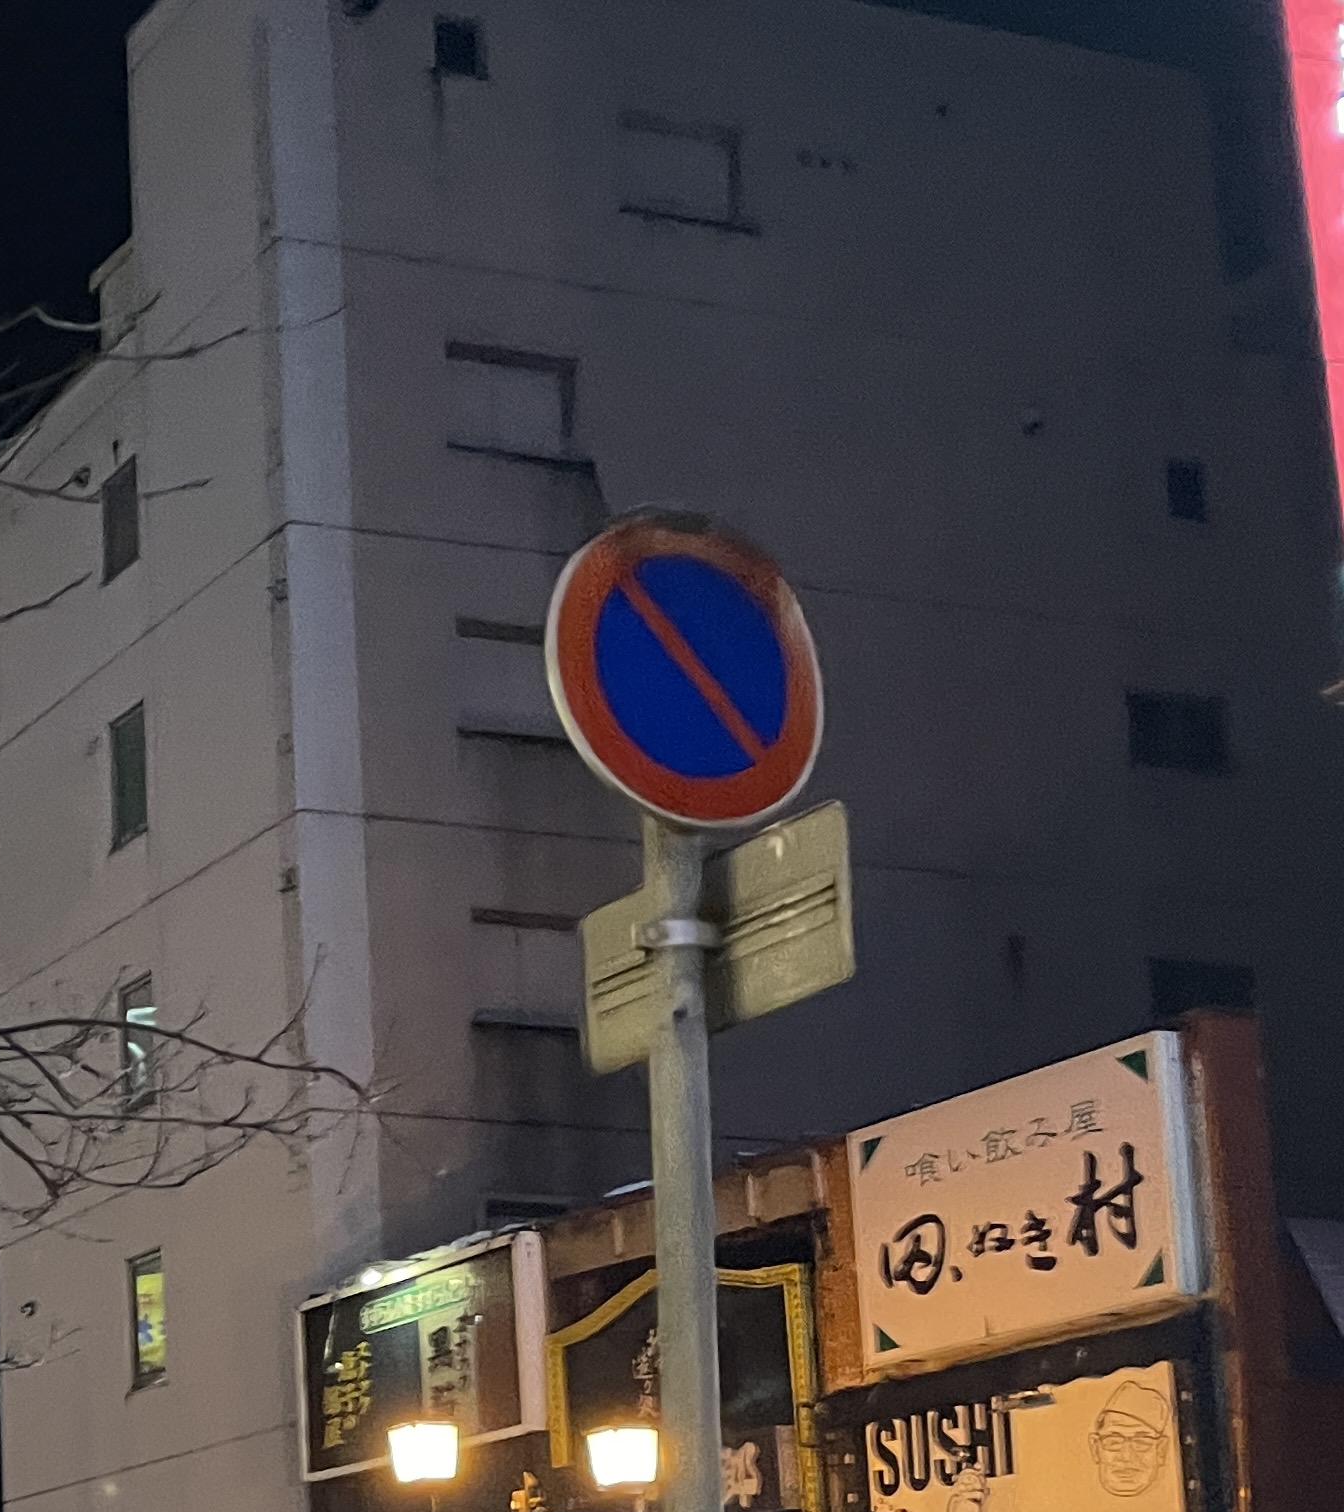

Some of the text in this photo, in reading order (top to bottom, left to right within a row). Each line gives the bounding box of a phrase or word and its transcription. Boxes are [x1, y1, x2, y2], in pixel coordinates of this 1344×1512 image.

[904, 1100, 1105, 1187] 喰い飲み屋
[869, 1402, 1016, 1497] SUSHI
